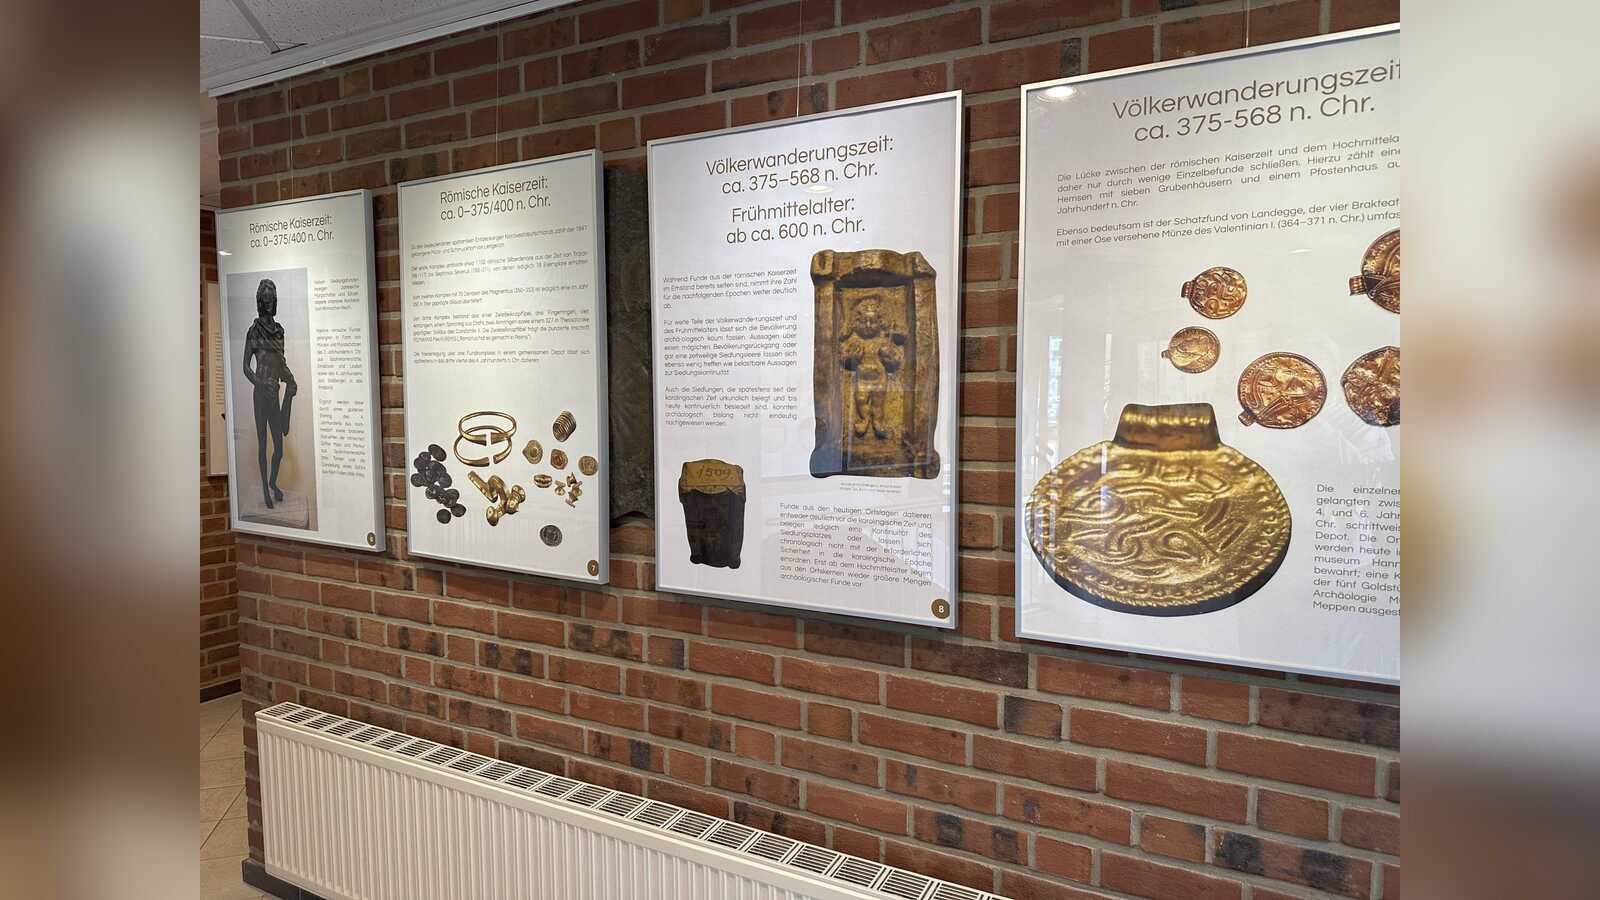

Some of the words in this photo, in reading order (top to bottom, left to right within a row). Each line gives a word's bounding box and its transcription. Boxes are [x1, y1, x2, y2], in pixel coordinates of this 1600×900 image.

[1134, 124, 1170, 142] ca.
[1176, 104, 1282, 137] 375-568
[1289, 106, 1312, 122] n.
[1319, 94, 1375, 118] Chr.
[705, 137, 894, 176] Völkerwanderungszeit:
[1057, 172, 1071, 182] Die
[1075, 169, 1101, 180] Lücke
[1104, 164, 1146, 176] zwischen
[1150, 162, 1165, 171] der
[1170, 156, 1220, 169] römischen
[1224, 149, 1272, 162] Kaiserzeit
[1278, 145, 1298, 156] und
[1302, 144, 1327, 153] dem
[722, 180, 745, 194] ca.
[750, 167, 820, 190] 375–568
[824, 168, 838, 181] n.
[843, 161, 878, 179] Chr.
[1057, 182, 1081, 193] daher
[1087, 181, 1102, 189] nur
[1106, 176, 1133, 187] durch
[1137, 173, 1171, 184] wenige
[1176, 164, 1244, 180] Einzelbefunde
[1249, 159, 1300, 172] schließen.
[1307, 155, 1341, 165] Hierzu
[1347, 150, 1374, 161] zählt
[1380, 148, 1400, 157] ein
[440, 185, 490, 205] Römische
[492, 176, 548, 196] Kaiserzeit:
[1057, 194, 1092, 204] Hemsen
[1099, 189, 1113, 199] mit
[1120, 186, 1151, 197] sieben
[1158, 179, 1232, 193] Grubenhäusern
[1240, 173, 1260, 184] und
[1269, 171, 1301, 181] einem
[1310, 163, 1378, 177] Pfostenhaus
[440, 209, 456, 221] ca.
[457, 199, 514, 218] 0–375/400
[515, 200, 526, 211] n.
[528, 194, 551, 209] Chr.
[732, 198, 855, 223] Frühmittelalter:
[1056, 201, 1110, 214] Jahrhundert
[1120, 199, 1138, 209] Chr.
[249, 219, 288, 234] Römische
[290, 213, 333, 229] Kaiserzeit:
[1056, 226, 1089, 236] Ebenso
[1090, 222, 1141, 233] bedeutsam
[1142, 219, 1153, 228] ist
[1155, 218, 1171, 227] der
[1173, 212, 1228, 226] Schatzfund
[1230, 213, 1248, 221] von
[1251, 208, 1305, 219] Landegge,
[1308, 205, 1326, 214] der
[1329, 203, 1348, 212] vier
[1056, 237, 1069, 246] mit
[1071, 236, 1092, 245] einer
[1094, 232, 1112, 243] Öse
[1113, 231, 1160, 242] versehene
[1161, 228, 1192, 238] Münze
[1194, 226, 1212, 235] des
[1214, 221, 1268, 233] Valentinian
[1277, 216, 1325, 230] (364–371
[1340, 212, 1365, 223] Chr.)
[250, 239, 262, 248] ca.
[263, 232, 307, 247] 0–375/400
[307, 233, 315, 242] n.
[316, 229, 335, 241] Chr.
[726, 226, 747, 243] ab
[750, 228, 774, 241] ca.
[778, 221, 809, 239] 600
[812, 223, 827, 236] n.
[831, 217, 866, 234] Chr.
[1316, 484, 1335, 493] Die
[1316, 496, 1370, 508] gelangten
[1315, 507, 1325, 516] 4.
[1331, 508, 1353, 517] und
[1359, 509, 1369, 518] 6.
[1315, 519, 1336, 528] Chr.
[1315, 531, 1350, 543] Depot.
[1359, 533, 1376, 542] Die
[1314, 543, 1353, 553] werden
[1359, 544, 1391, 555] heute
[1314, 555, 1360, 565] museum
[1314, 565, 1360, 578] bewahrt;
[1365, 569, 1389, 579] eine
[1313, 577, 1331, 587] der
[1335, 578, 1356, 588] fünf
[1312, 589, 1376, 603] Archäologie
[938, 605, 945, 613] 8
[1312, 600, 1355, 613] Meppen
